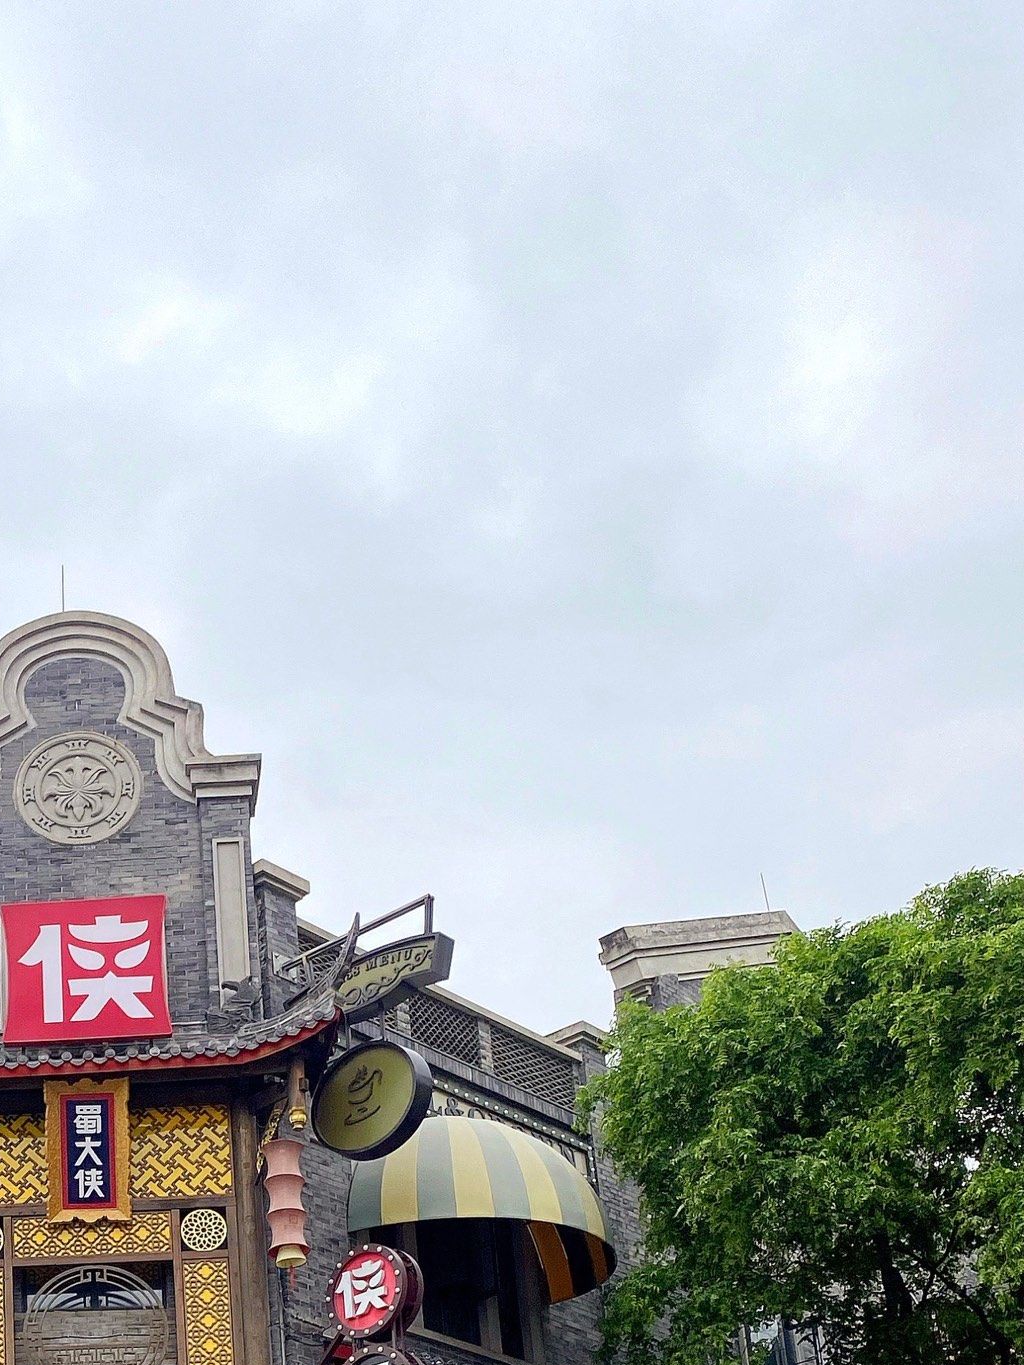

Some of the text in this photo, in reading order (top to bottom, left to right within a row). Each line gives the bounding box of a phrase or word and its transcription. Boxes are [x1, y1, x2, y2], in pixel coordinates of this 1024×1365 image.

[366, 949, 413, 971] MENU
[73, 1104, 105, 1198] 蜀大侠
